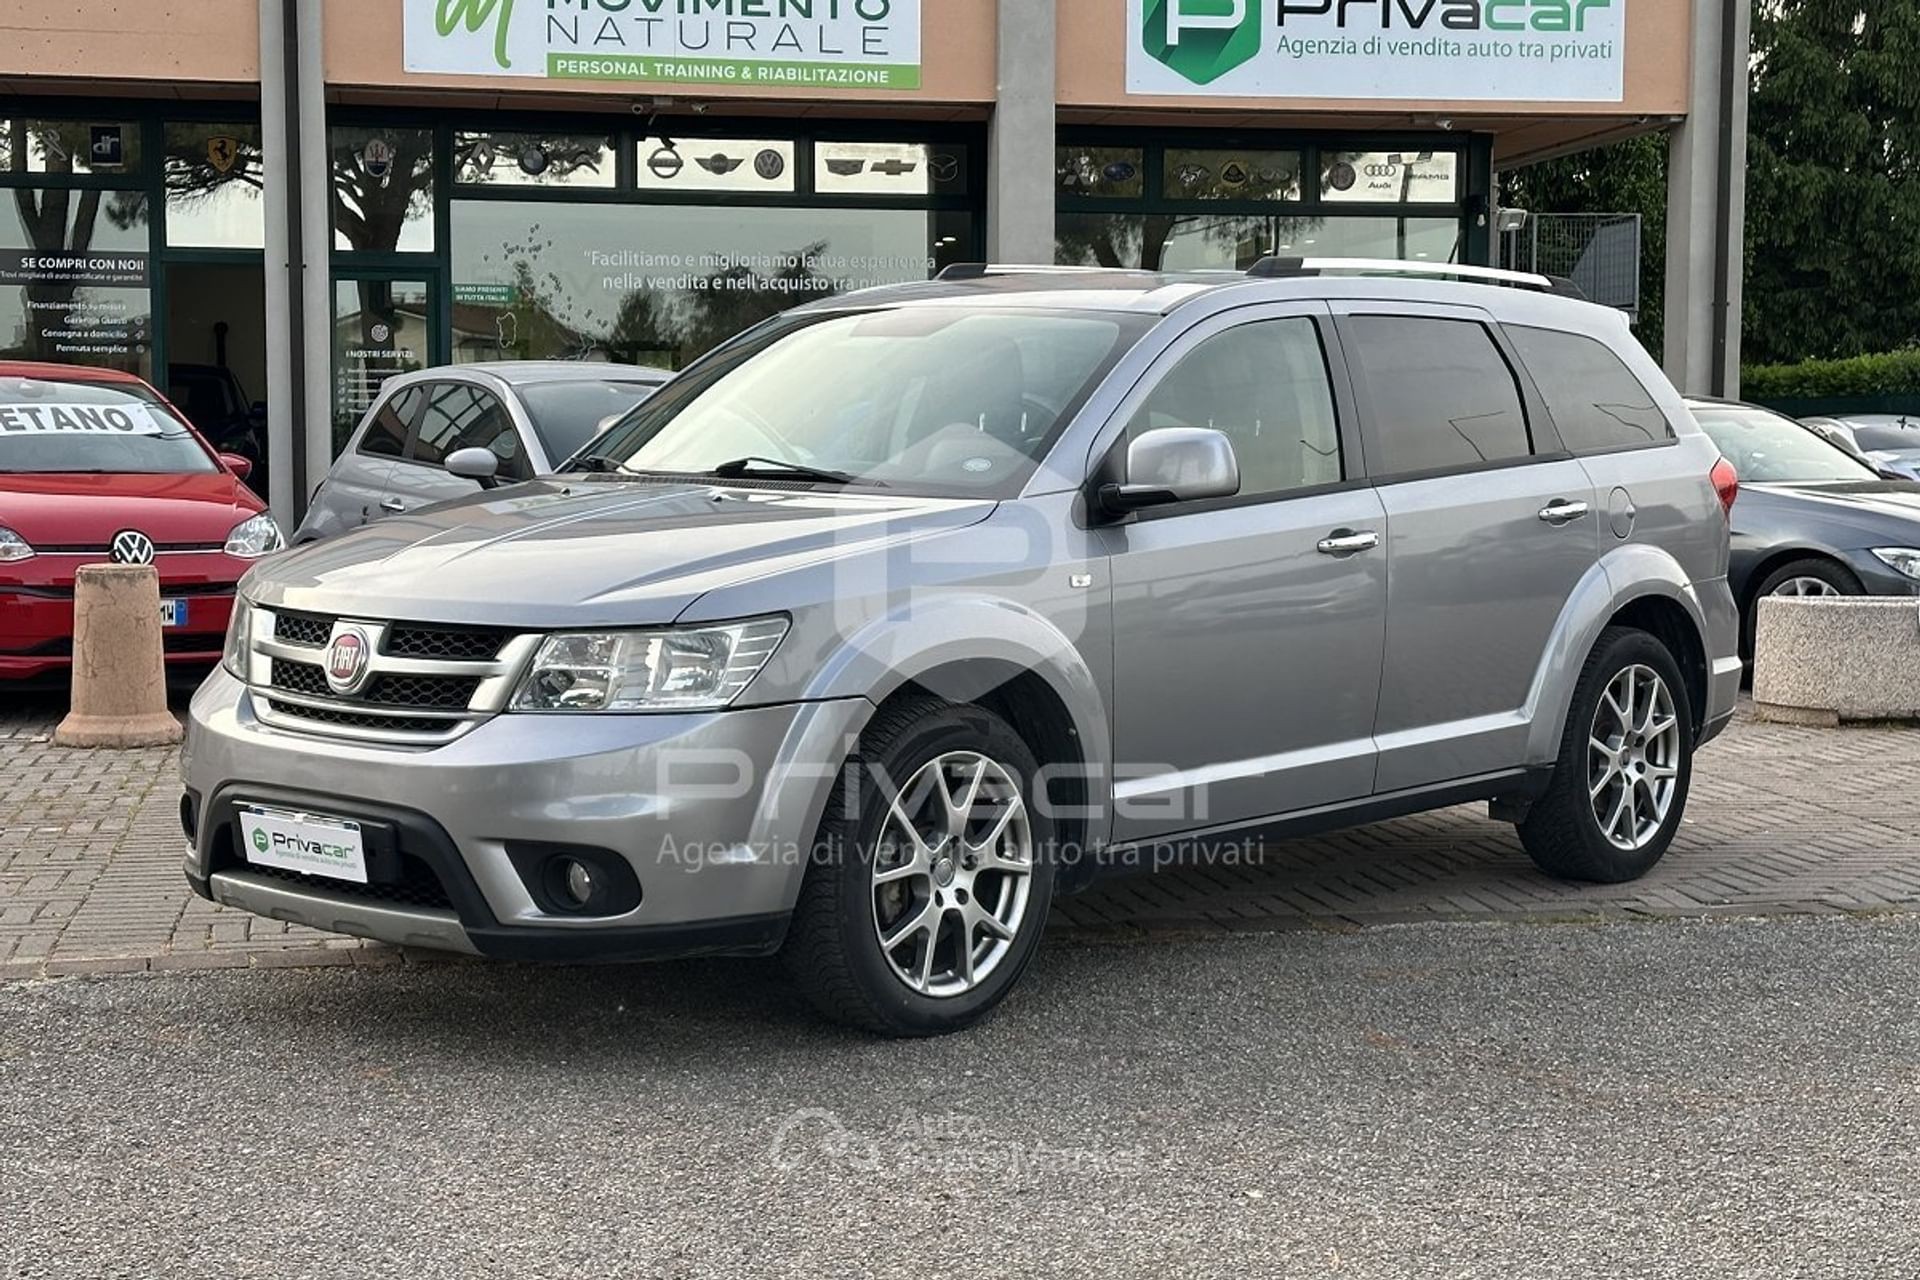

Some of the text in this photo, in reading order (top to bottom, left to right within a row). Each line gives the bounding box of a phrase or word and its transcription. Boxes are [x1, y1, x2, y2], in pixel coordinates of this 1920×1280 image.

[547, 15, 889, 55] NATURALE
[1277, 35, 1612, 63] Agenzia di vendita auto tra privati
[556, 59, 889, 84] PERSONAL TRAINING & RIABILITAZIONE
[20, 257, 36, 269] SE
[38, 258, 86, 270] COMPRI
[89, 259, 115, 270] CON
[684, 254, 694, 267] e
[699, 251, 797, 271] miglioriamo
[801, 251, 815, 268] la
[819, 253, 846, 268] tua
[603, 272, 642, 289] nella
[646, 272, 708, 290] vendita
[712, 277, 722, 290] e
[833, 276, 854, 291] tra
[42, 329, 82, 339] Consegna
[90, 329, 128, 339] domicilio
[56, 343, 128, 355] Permuta semplice
[350, 350, 381, 358] NOSTRI
[333, 644, 358, 670] FIAT
[272, 832, 355, 859] Privacar
